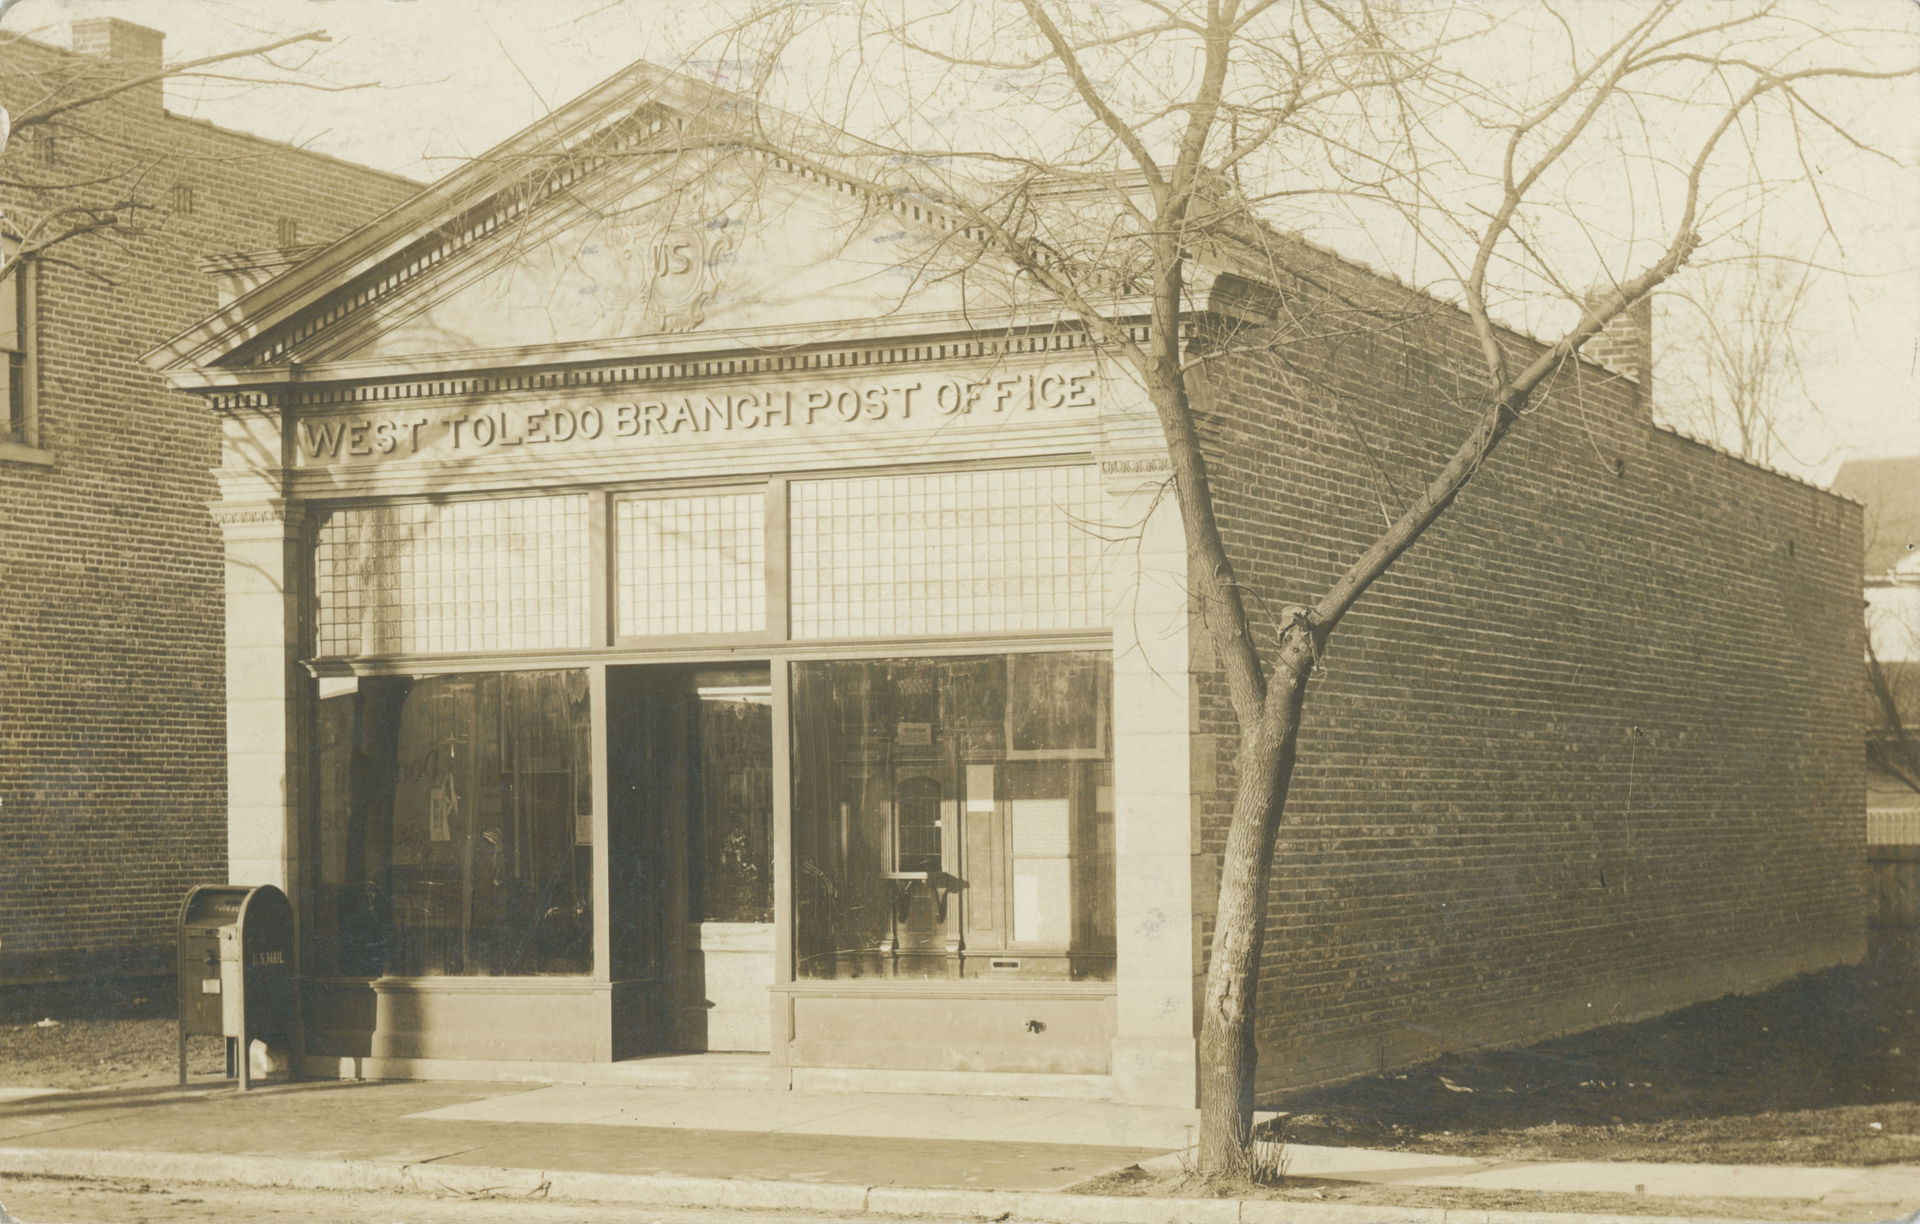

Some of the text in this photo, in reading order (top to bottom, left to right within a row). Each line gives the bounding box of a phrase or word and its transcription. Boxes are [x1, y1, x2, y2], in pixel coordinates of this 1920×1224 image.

[653, 242, 691, 277] US
[301, 370, 1096, 458] WEST TOLEDO BRANCH POST OFFICE
